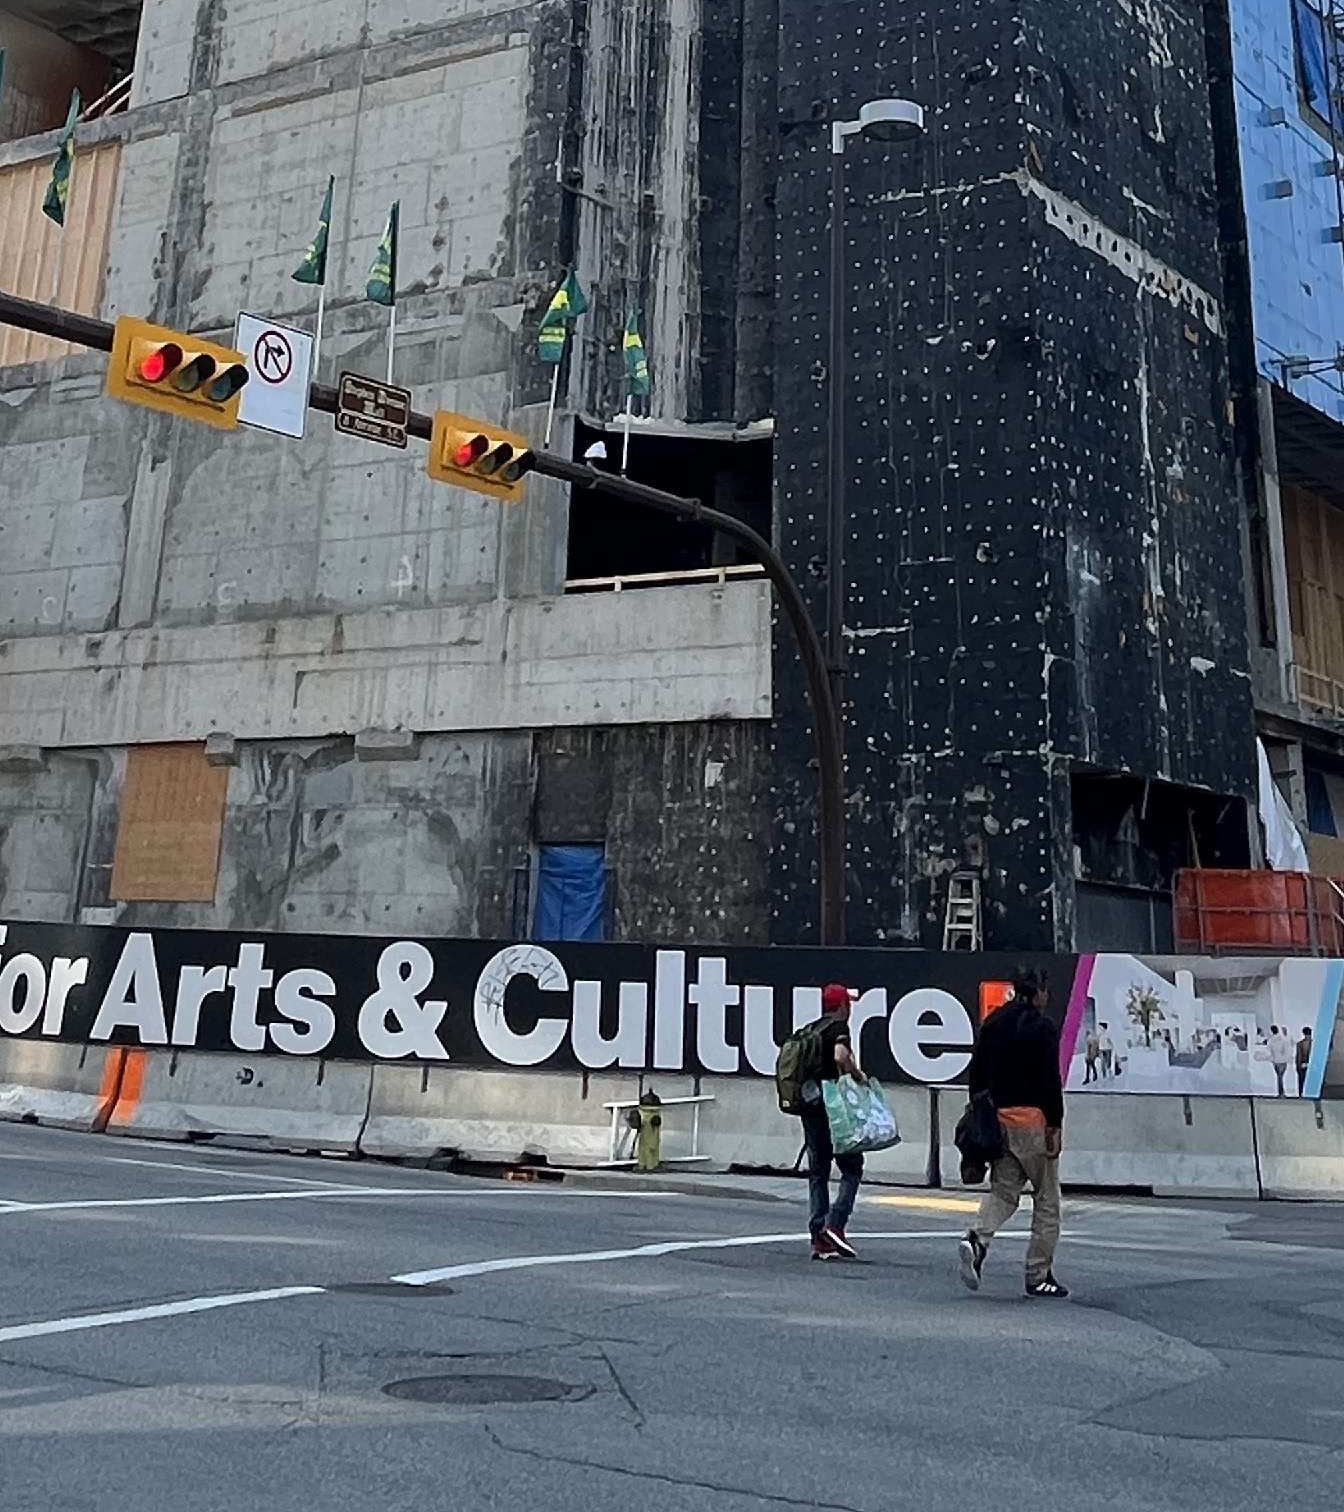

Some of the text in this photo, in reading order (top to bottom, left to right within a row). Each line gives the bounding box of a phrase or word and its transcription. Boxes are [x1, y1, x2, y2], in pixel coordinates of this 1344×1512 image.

[89, 932, 337, 1055] Arts
[357, 940, 450, 1060] &
[473, 944, 974, 1082] Culture
